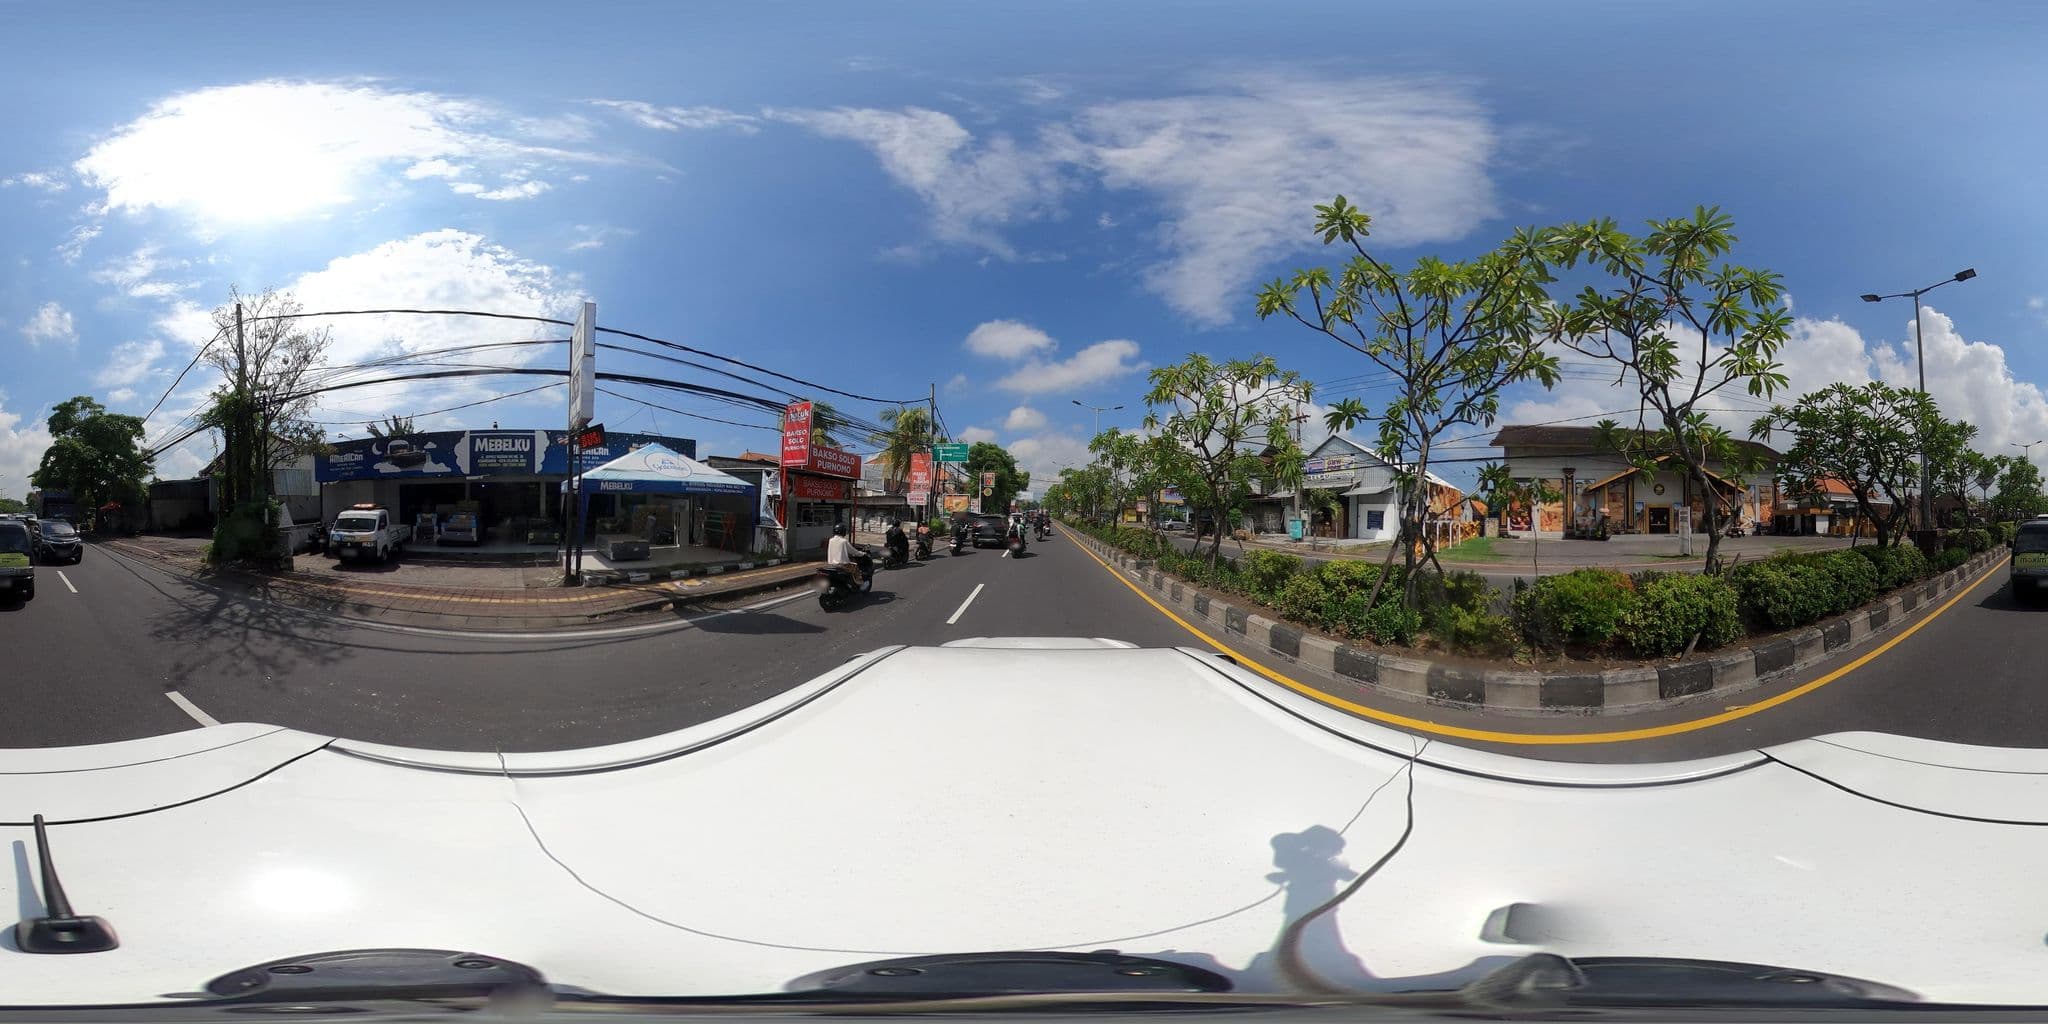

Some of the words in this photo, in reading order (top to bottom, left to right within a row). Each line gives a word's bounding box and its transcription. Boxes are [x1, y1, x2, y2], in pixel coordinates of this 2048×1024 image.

[786, 429, 807, 437] BAKSO
[475, 438, 530, 451] MEBELKU
[812, 448, 838, 460] BAKSO
[838, 454, 855, 465] SOLO
[817, 461, 851, 474] PURNOMO
[600, 482, 633, 491] MEBELKU
[802, 479, 823, 488] BAKSO
[823, 481, 837, 490] SOLO
[806, 488, 834, 497] PURNOMO
